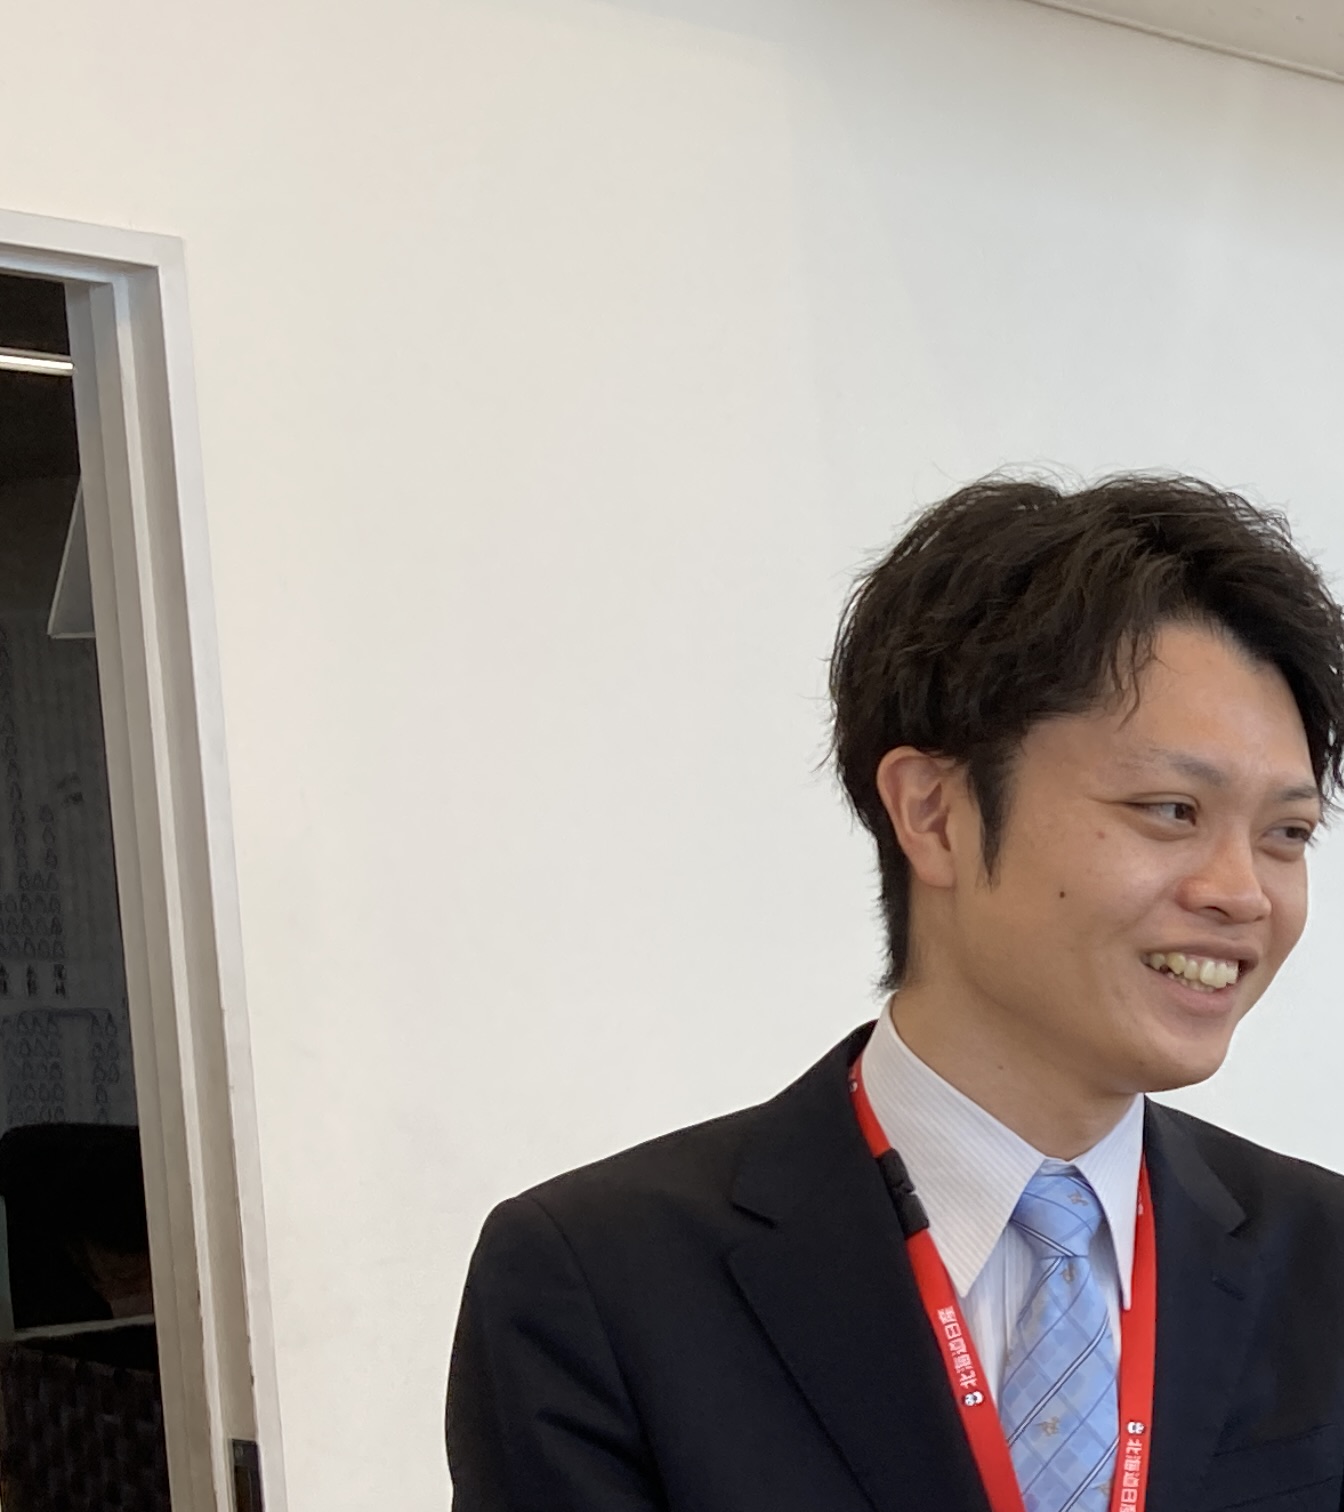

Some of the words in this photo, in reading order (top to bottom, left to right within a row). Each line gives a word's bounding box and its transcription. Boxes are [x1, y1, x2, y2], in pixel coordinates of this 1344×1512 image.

[937, 1305, 978, 1389] 北海道日産
